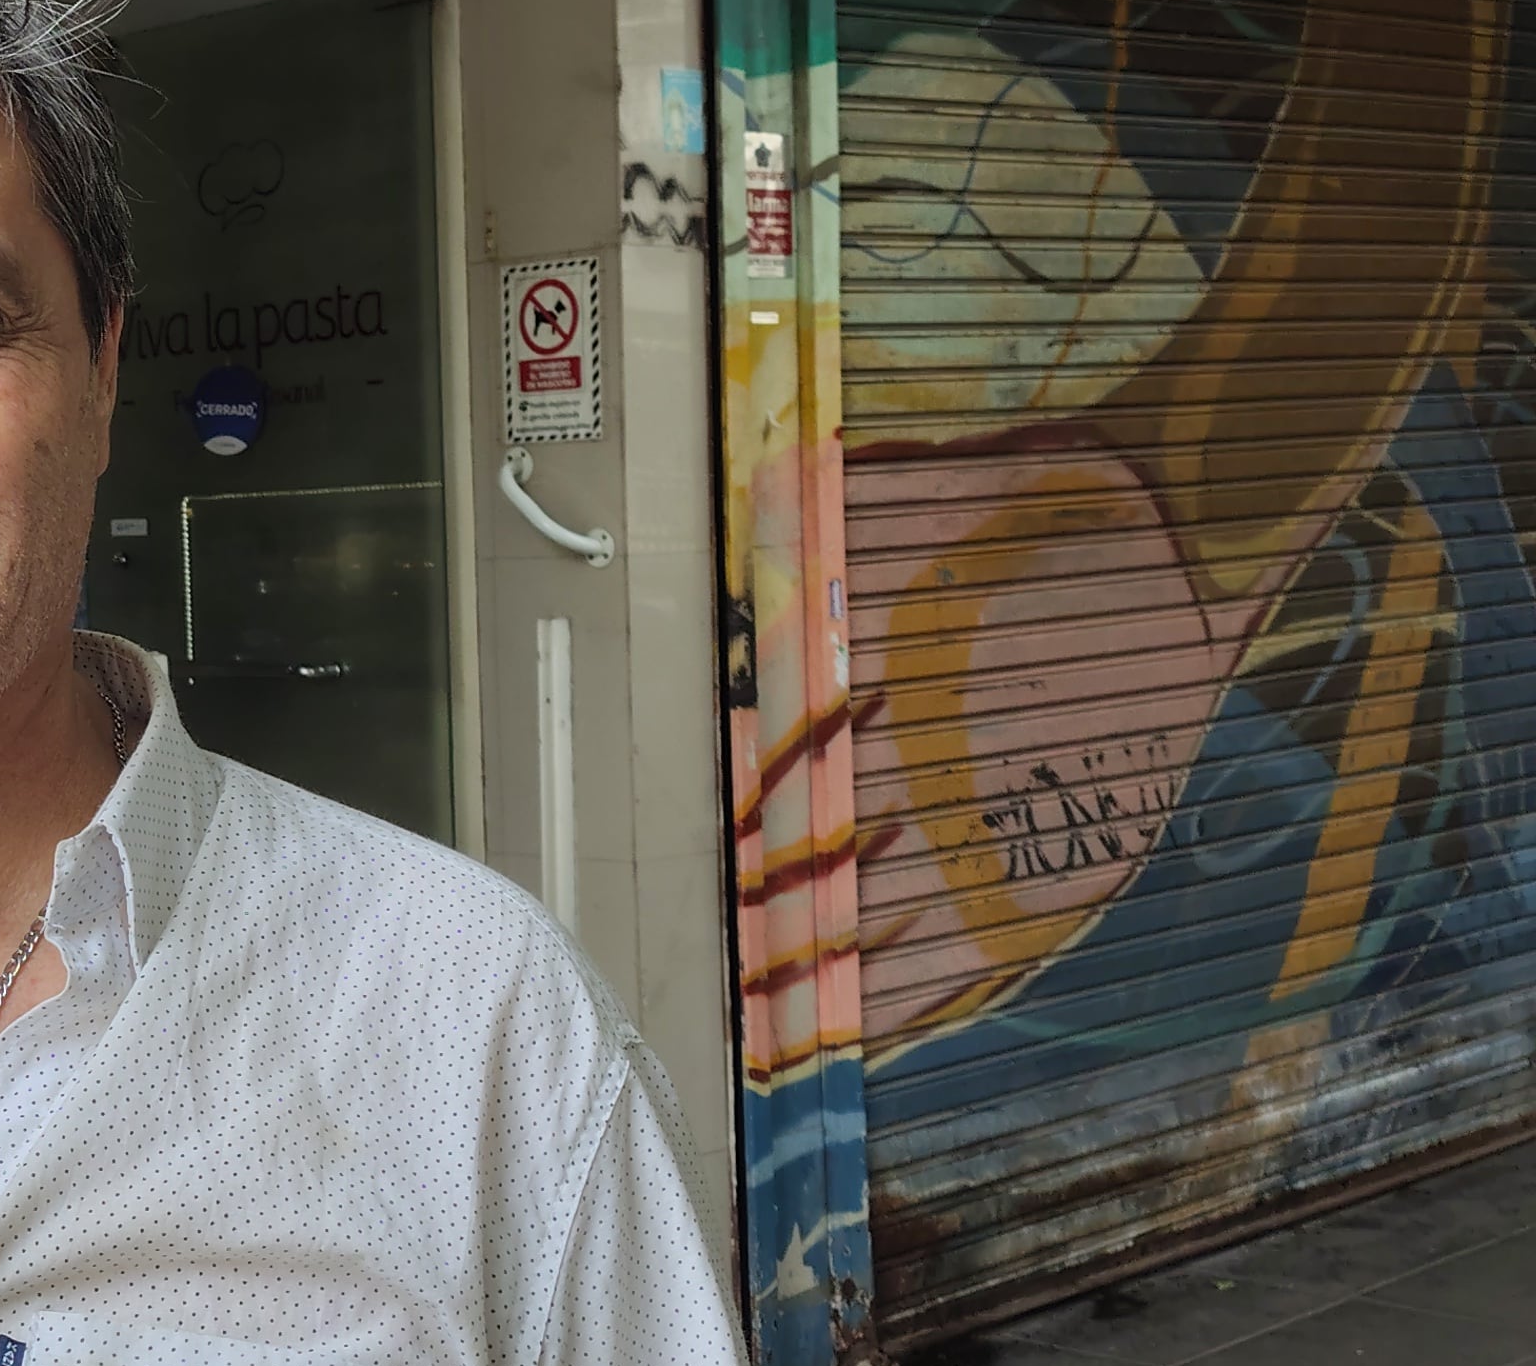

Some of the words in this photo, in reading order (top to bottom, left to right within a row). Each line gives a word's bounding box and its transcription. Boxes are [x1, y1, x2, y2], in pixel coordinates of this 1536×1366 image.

[203, 290, 247, 353] la
[252, 282, 390, 371] pasta
[200, 402, 255, 417] CERRADO
